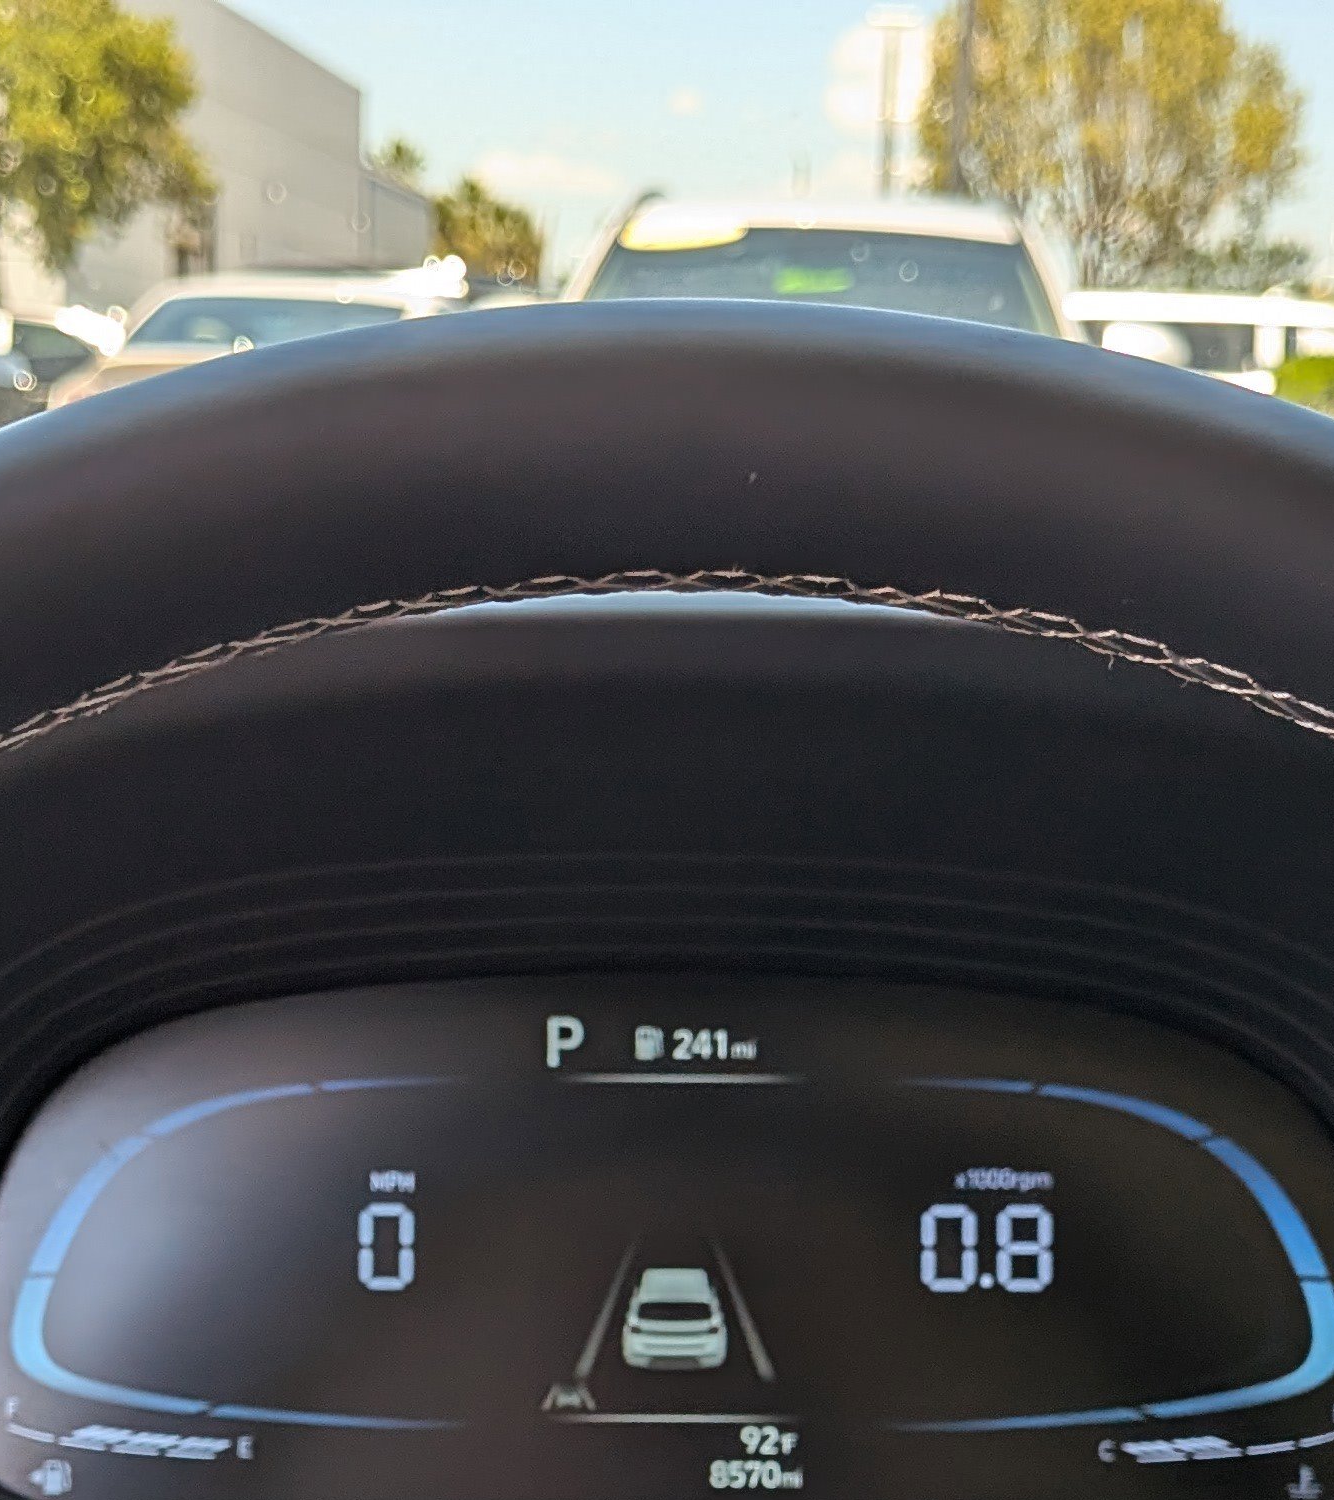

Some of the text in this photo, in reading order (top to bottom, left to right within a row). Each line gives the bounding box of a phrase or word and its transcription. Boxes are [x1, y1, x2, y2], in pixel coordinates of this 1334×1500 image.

[546, 1014, 584, 1068] P
[369, 1169, 416, 1193] MPH
[357, 1202, 415, 1291] 0
[919, 1203, 1055, 1293] 0.8
[1097, 1438, 1117, 1462] C
